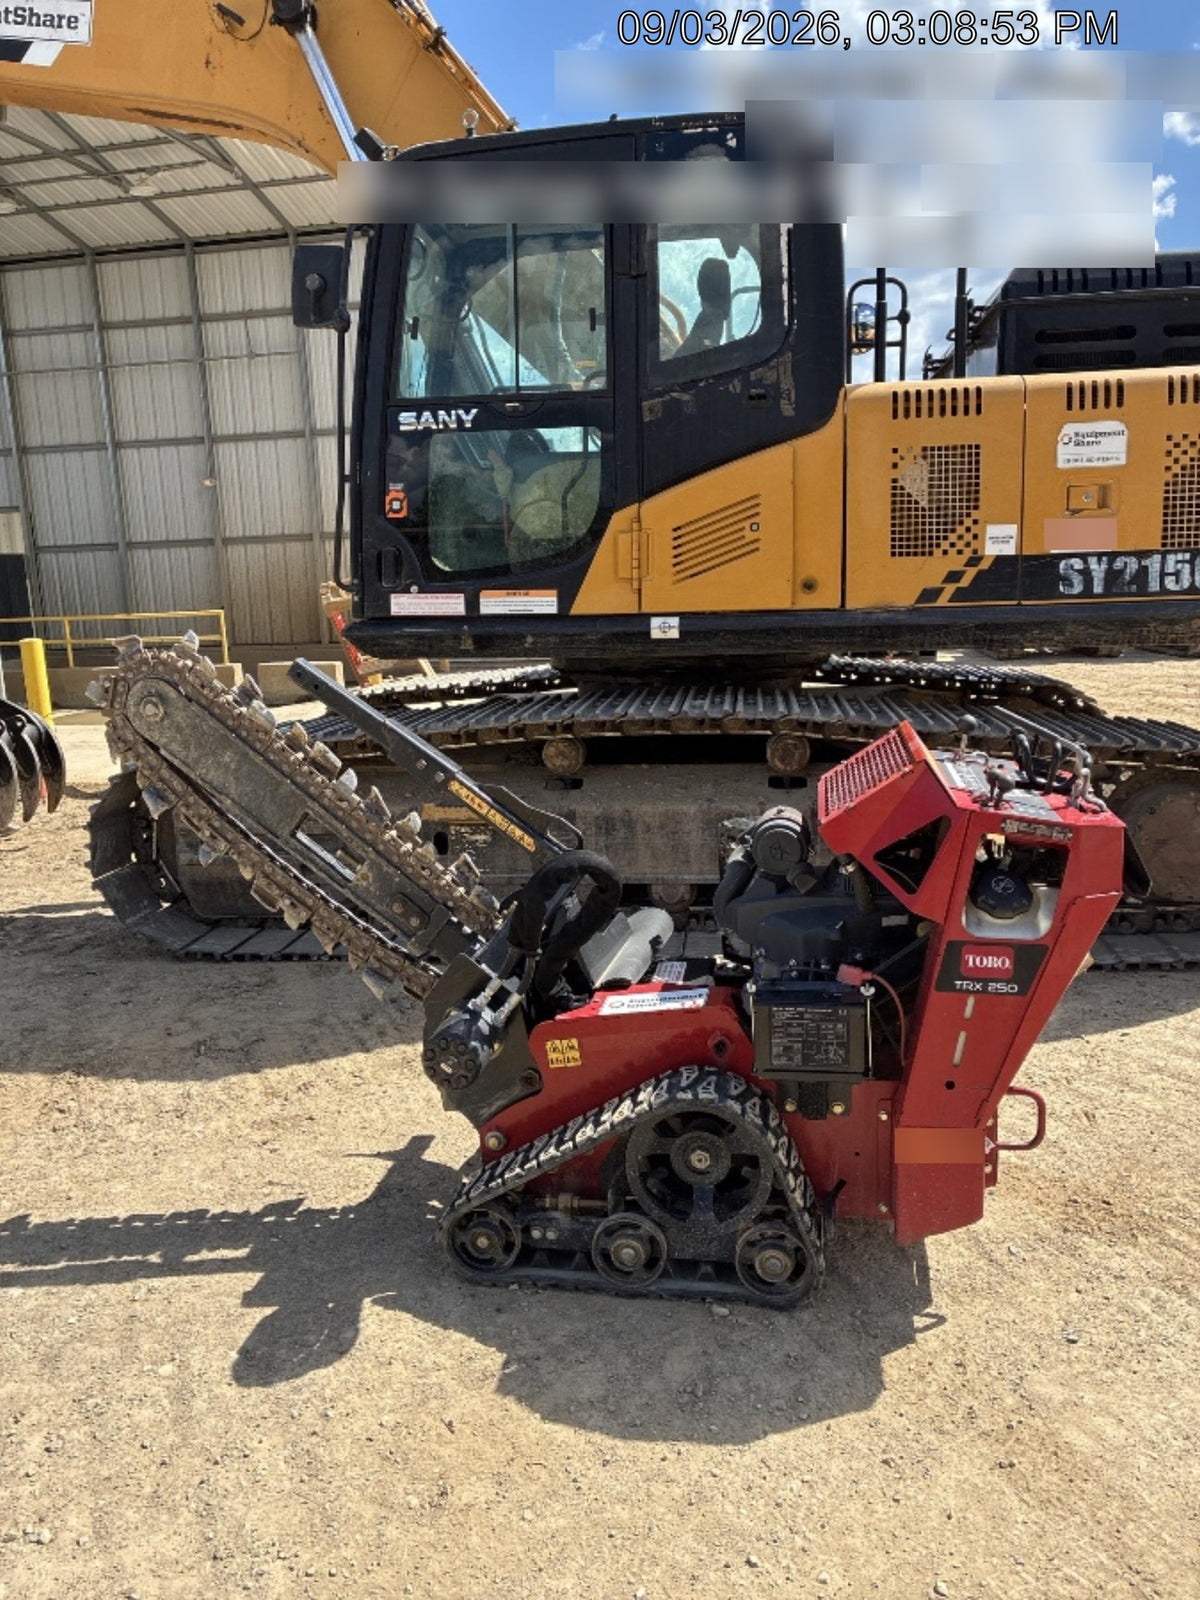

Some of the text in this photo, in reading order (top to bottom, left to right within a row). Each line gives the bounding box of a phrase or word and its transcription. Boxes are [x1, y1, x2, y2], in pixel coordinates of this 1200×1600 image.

[0, 6, 79, 30] tShare
[398, 408, 479, 431] SANY
[1059, 553, 1200, 594] SY215
[965, 954, 1010, 970] TORO
[954, 981, 1018, 993] TRX 250
